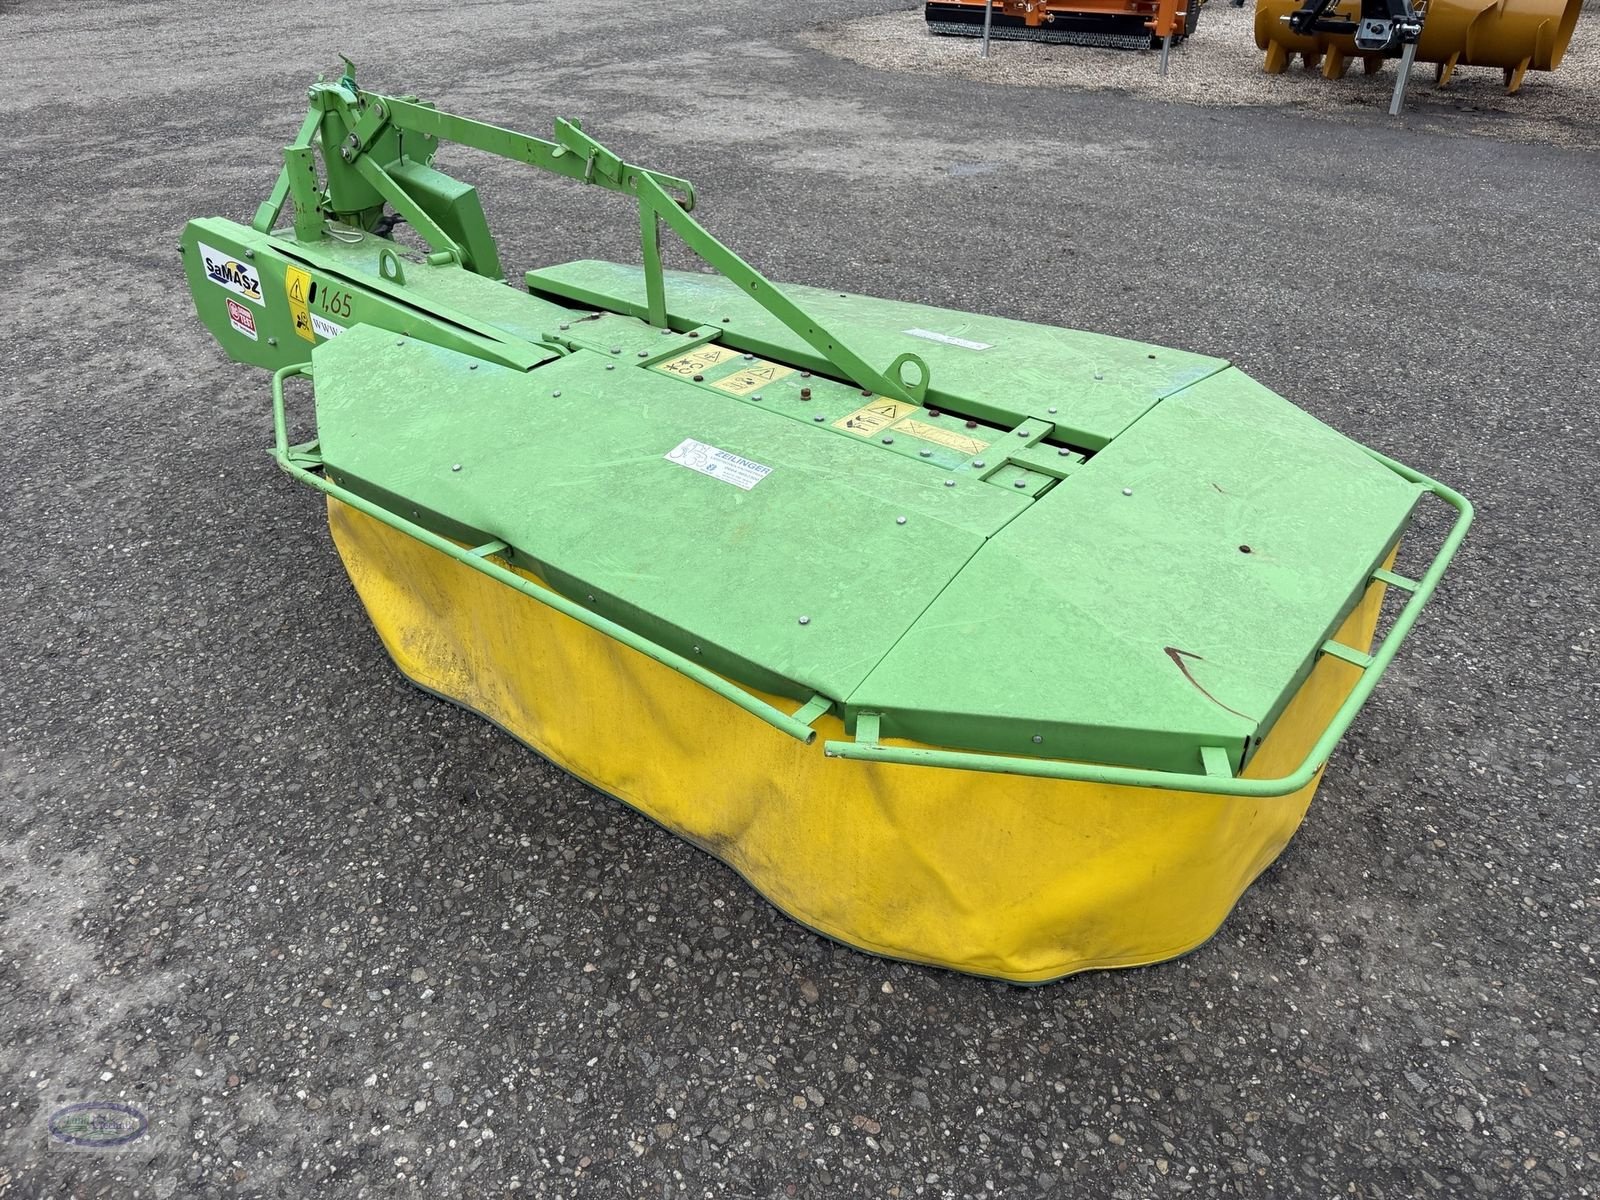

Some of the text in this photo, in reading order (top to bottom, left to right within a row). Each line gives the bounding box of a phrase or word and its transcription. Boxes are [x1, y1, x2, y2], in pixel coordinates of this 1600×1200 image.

[205, 257, 260, 294] SaMASZ
[321, 286, 352, 318] 1,65
[714, 450, 770, 474] ZEILINGER
